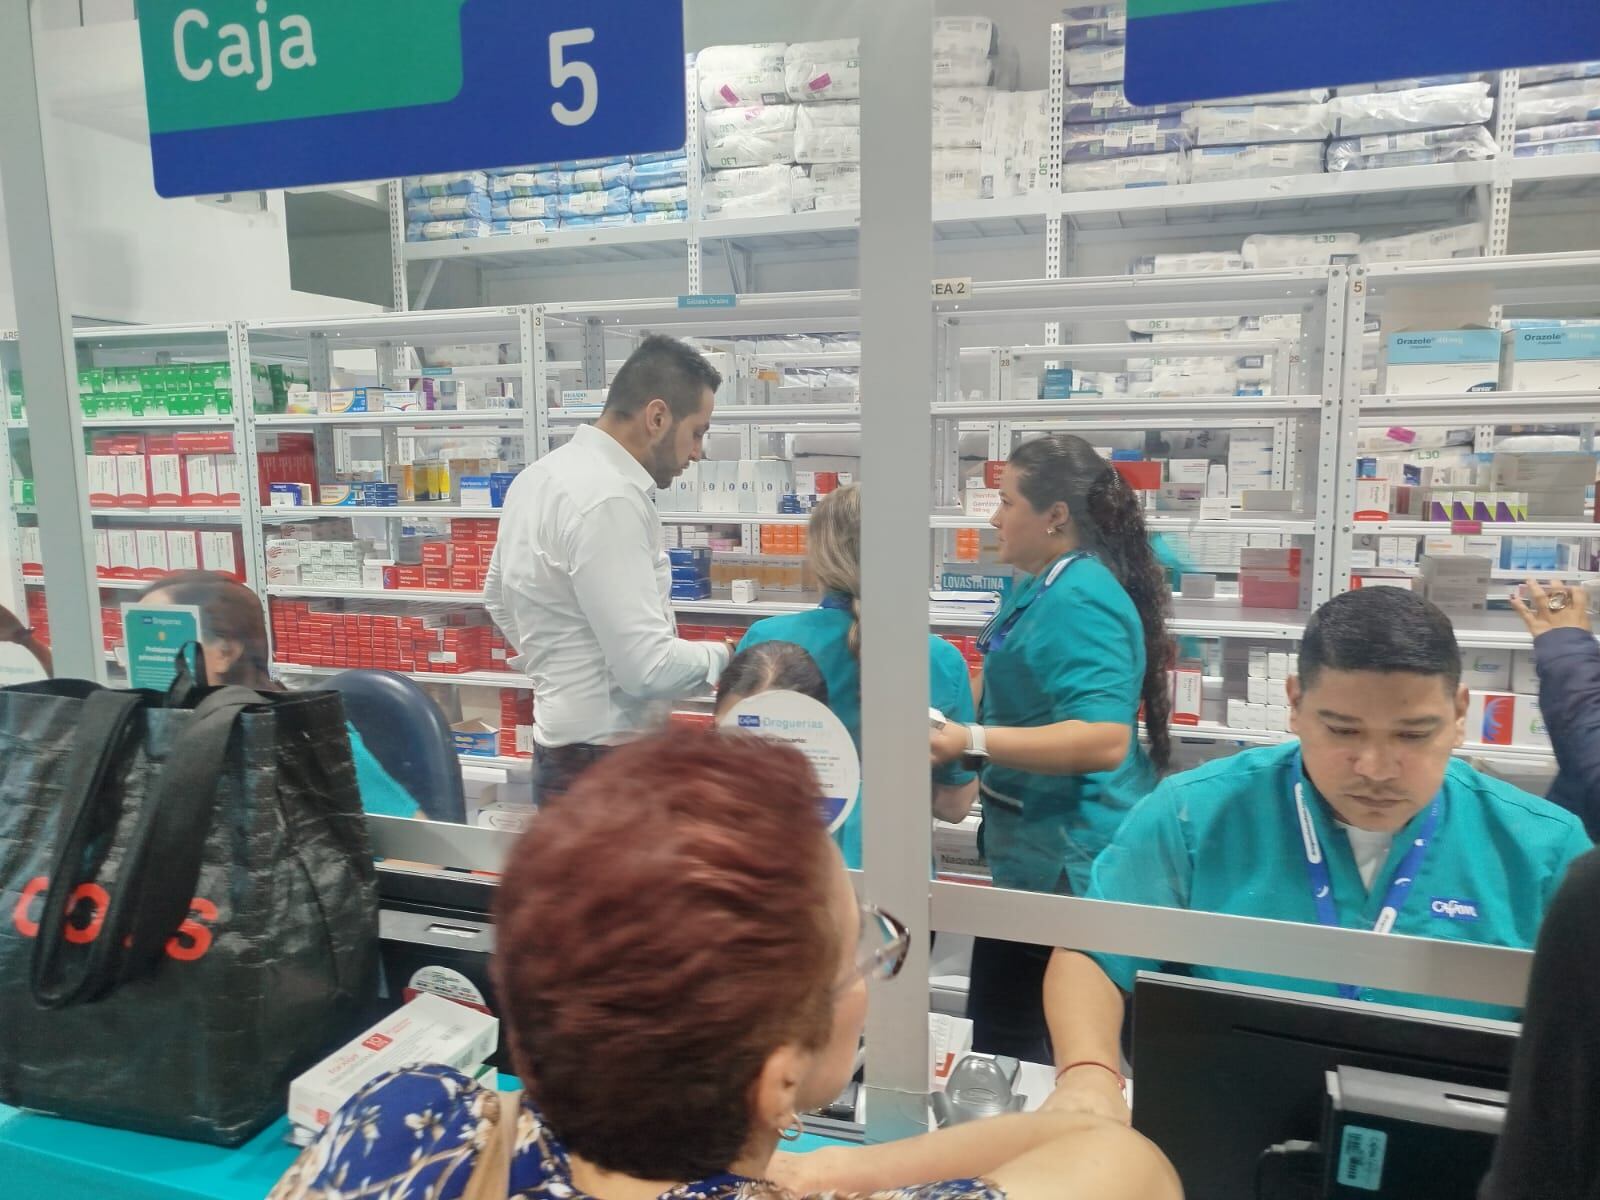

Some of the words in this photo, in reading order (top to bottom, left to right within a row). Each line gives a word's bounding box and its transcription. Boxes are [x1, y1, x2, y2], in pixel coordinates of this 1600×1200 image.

[172, 0, 318, 92] Caja
[549, 27, 599, 127] 5
[931, 283, 954, 295] EA
[956, 281, 966, 294] 2
[1353, 281, 1363, 294] 5
[534, 317, 542, 328] 3
[240, 332, 247, 343] 2
[12, 874, 220, 962] COS
